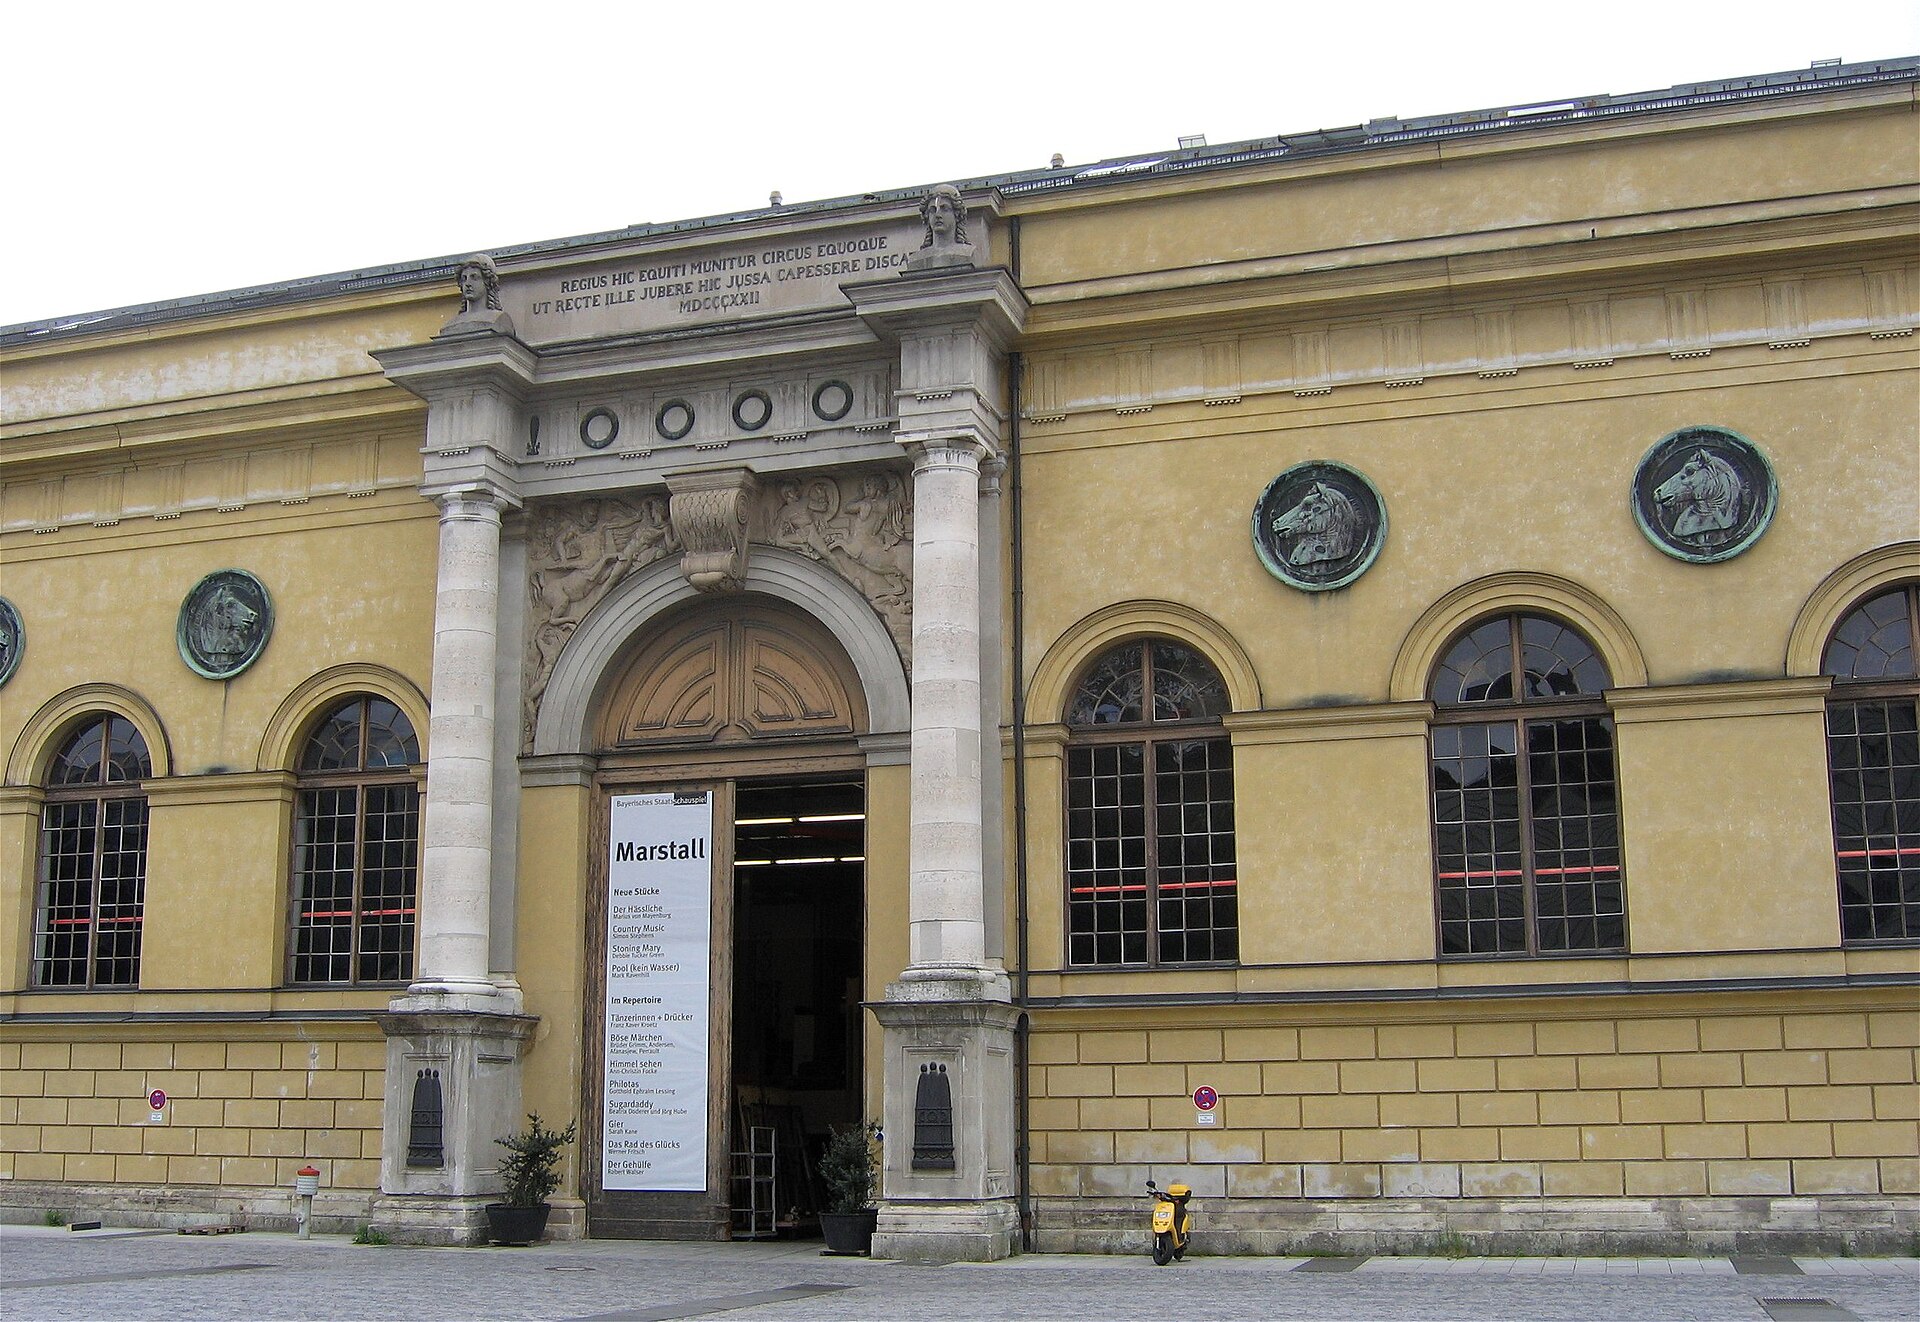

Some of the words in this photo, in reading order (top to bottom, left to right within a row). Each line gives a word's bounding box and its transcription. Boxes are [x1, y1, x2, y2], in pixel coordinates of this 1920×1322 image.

[561, 276, 607, 293] REGIUS
[612, 271, 634, 286] HIC
[638, 264, 686, 282] EQUITI
[690, 254, 756, 275] MUNITUR
[762, 247, 811, 265] CIRCUS
[817, 236, 887, 257] EQUOQUE
[533, 302, 551, 315] UT
[555, 295, 600, 313] RECTE
[605, 290, 635, 306] ILLE
[639, 282, 693, 300] JUBERE
[698, 278, 721, 293] HIC
[726, 271, 771, 289] JUSSA
[777, 259, 861, 282] CAPESSERE
[679, 291, 760, 313] MDCCCXXII
[617, 799, 652, 808] Bayerisches
[616, 838, 705, 861] Marstall
[634, 887, 660, 895] Stücke
[628, 905, 663, 913] Hässliche
[613, 925, 641, 933] Country
[612, 945, 640, 953] Stoning
[642, 944, 661, 953] Mary
[612, 964, 628, 972] Pool
[630, 963, 648, 972] (kein
[650, 963, 679, 972] Wasser)
[623, 996, 662, 1005] Repertoire
[611, 1014, 656, 1022] Tänzerinnen
[664, 1013, 694, 1021] Drücker
[610, 1060, 638, 1068] Himmel
[609, 1080, 639, 1088] Philotas
[609, 1100, 654, 1109] Sugardaddy
[609, 1120, 624, 1128] Gier
[624, 1140, 638, 1148] Rad
[640, 1140, 653, 1148] des
[655, 1140, 680, 1148] Glücks
[622, 1160, 652, 1169] Gehülfe
